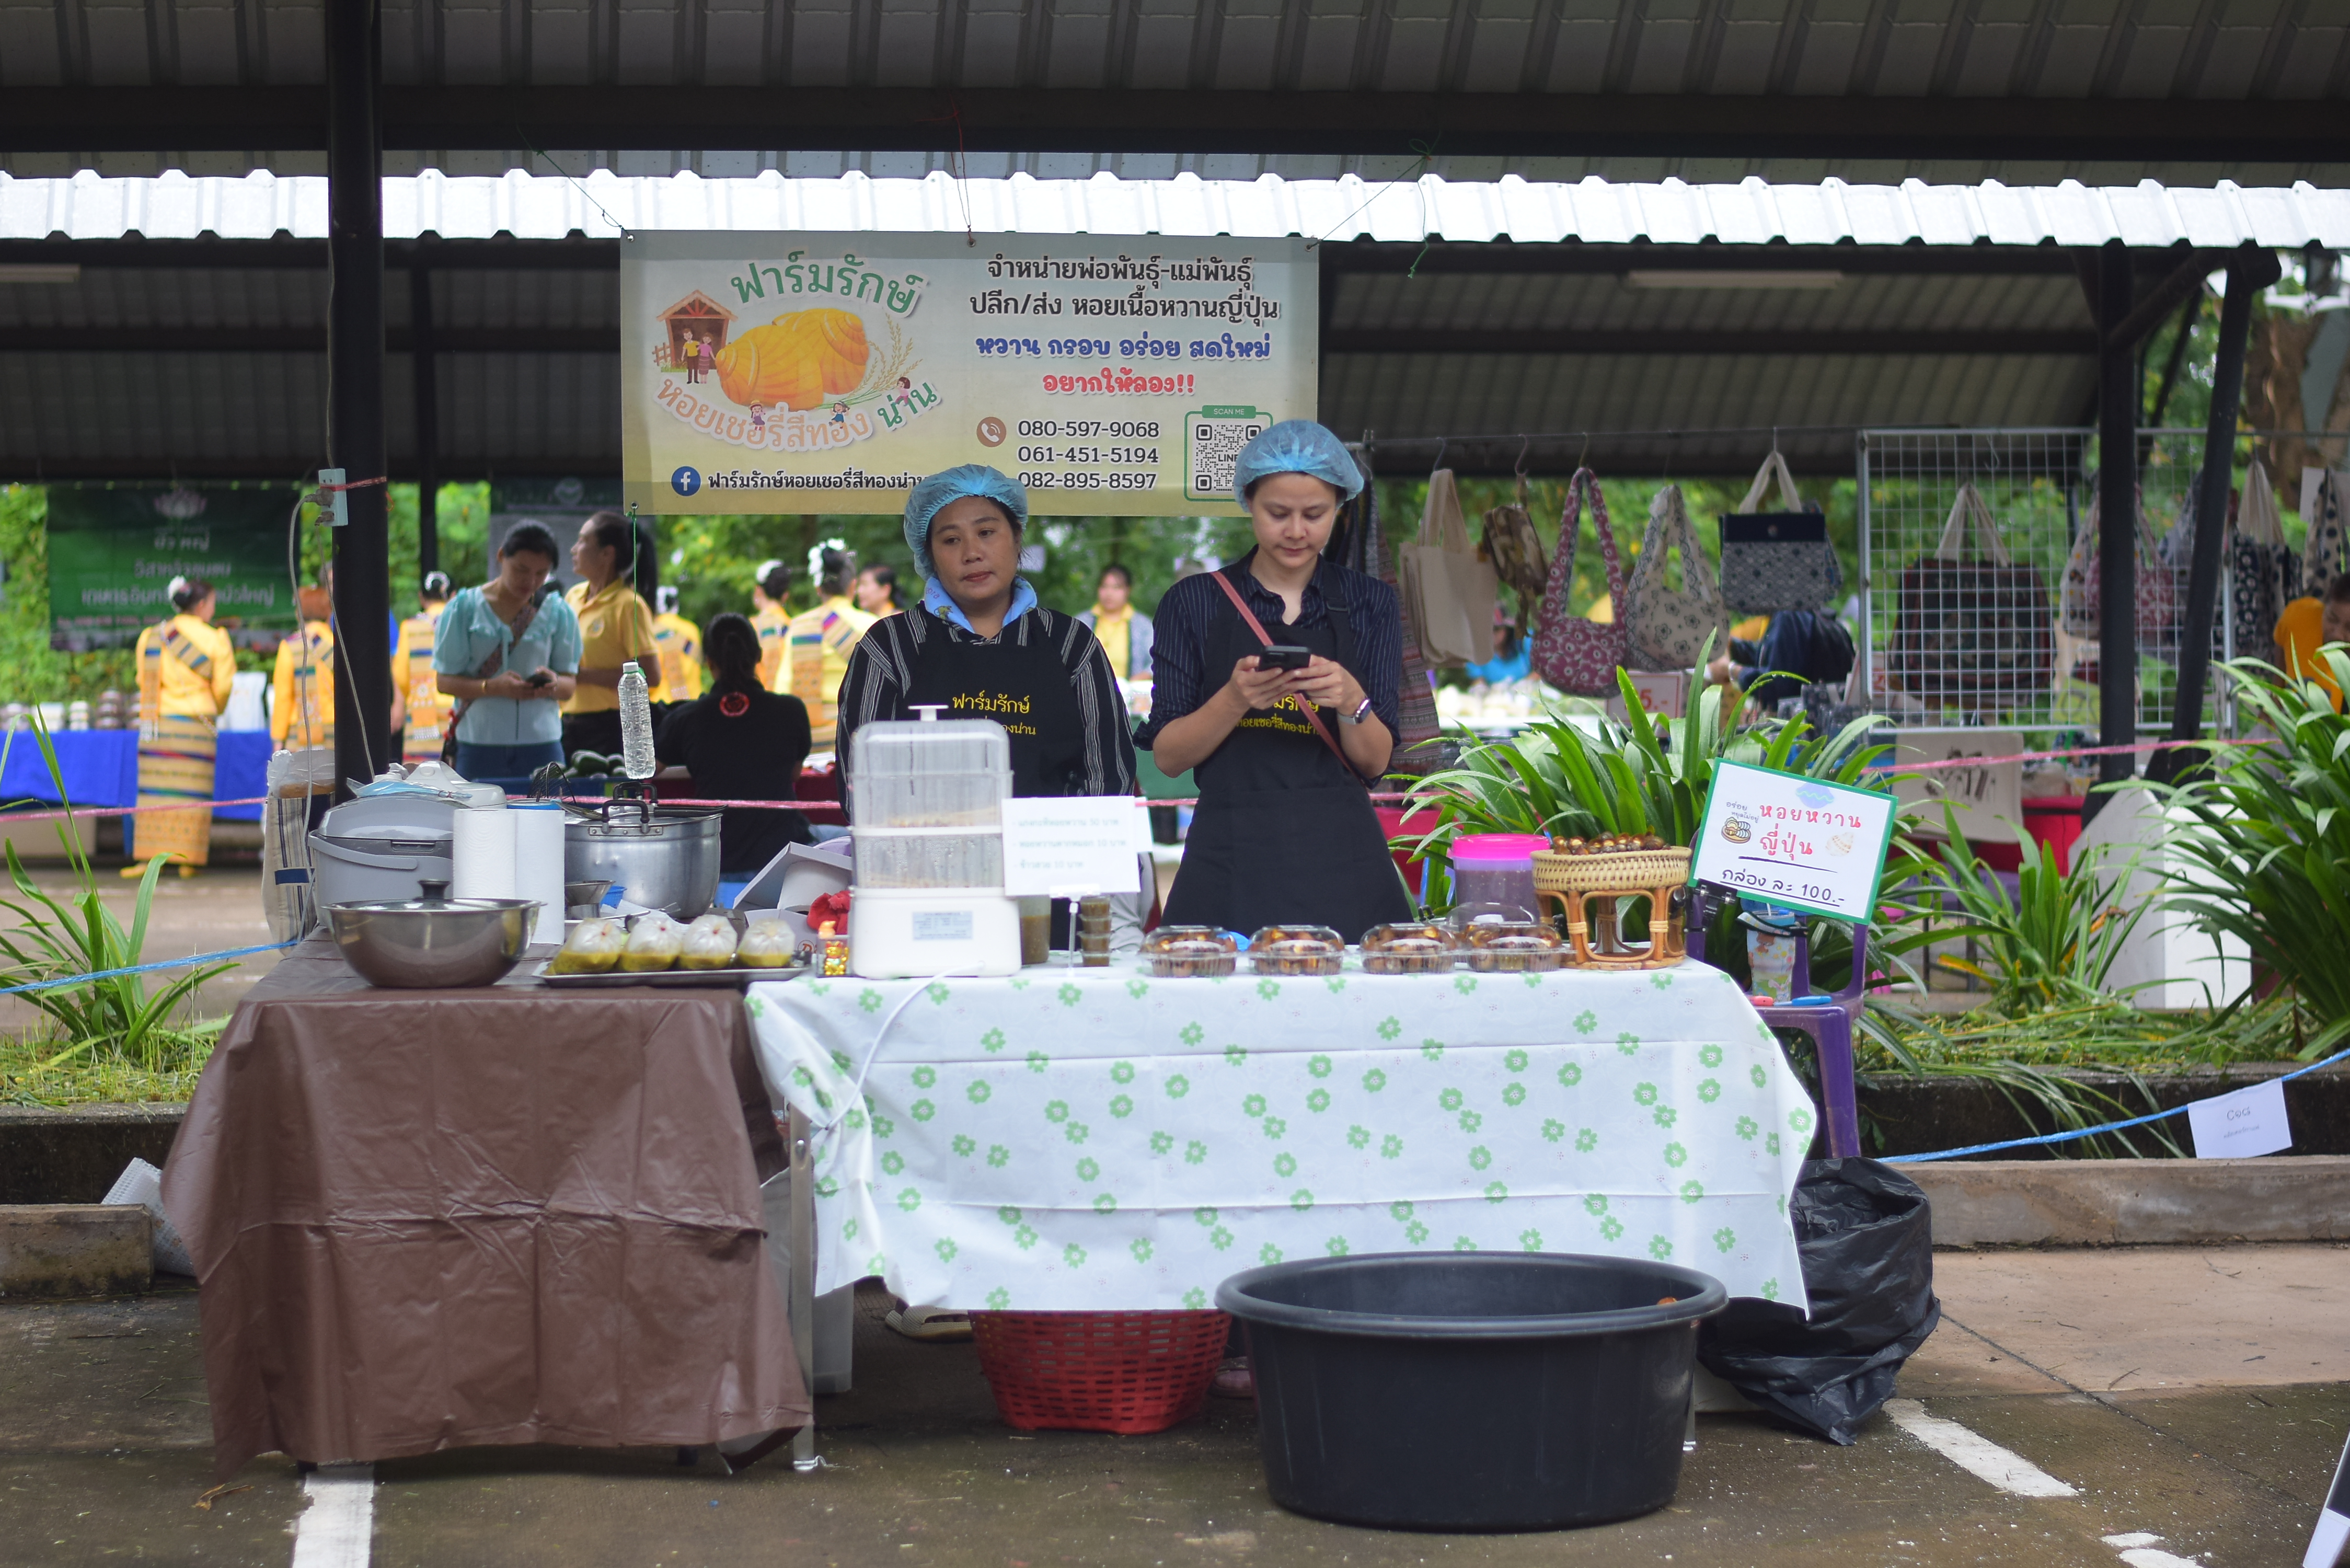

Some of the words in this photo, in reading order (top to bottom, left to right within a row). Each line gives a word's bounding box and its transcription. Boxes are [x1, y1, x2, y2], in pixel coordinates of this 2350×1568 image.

[731, 250, 924, 313] ฟาร์มรักษ์
[987, 253, 1252, 291] จำหน่ายพ่อพันธุ์-แม่พันธุ์
[970, 290, 1062, 316] ปลีก/ส่ง
[1072, 285, 1278, 327] หอยเนื้อหวานญี่ปุ่น
[976, 336, 1041, 356] หวาน
[1048, 337, 1111, 357] กรอบ
[1120, 331, 1181, 359] อร่อย
[1189, 333, 1271, 359] สดใหม่
[1042, 367, 1195, 395] อยากให้ลอง!!
[1018, 420, 1160, 438] 080-597-9068
[1018, 446, 1158, 464] 061-451-5194
[1019, 471, 1157, 489] 082-895-8597
[952, 689, 1030, 714] ฟาร์มรักษ์
[1237, 712, 1320, 736] อยเชอรี่สีทองน่า
[1726, 801, 1748, 811] อร่อย
[1759, 804, 1861, 828] หอยหวาน
[1759, 823, 1813, 861] ญี่ปุ่น
[1722, 868, 1767, 887] กล่อง
[1772, 880, 1793, 892] ละ
[1801, 883, 1845, 904] 100.-
